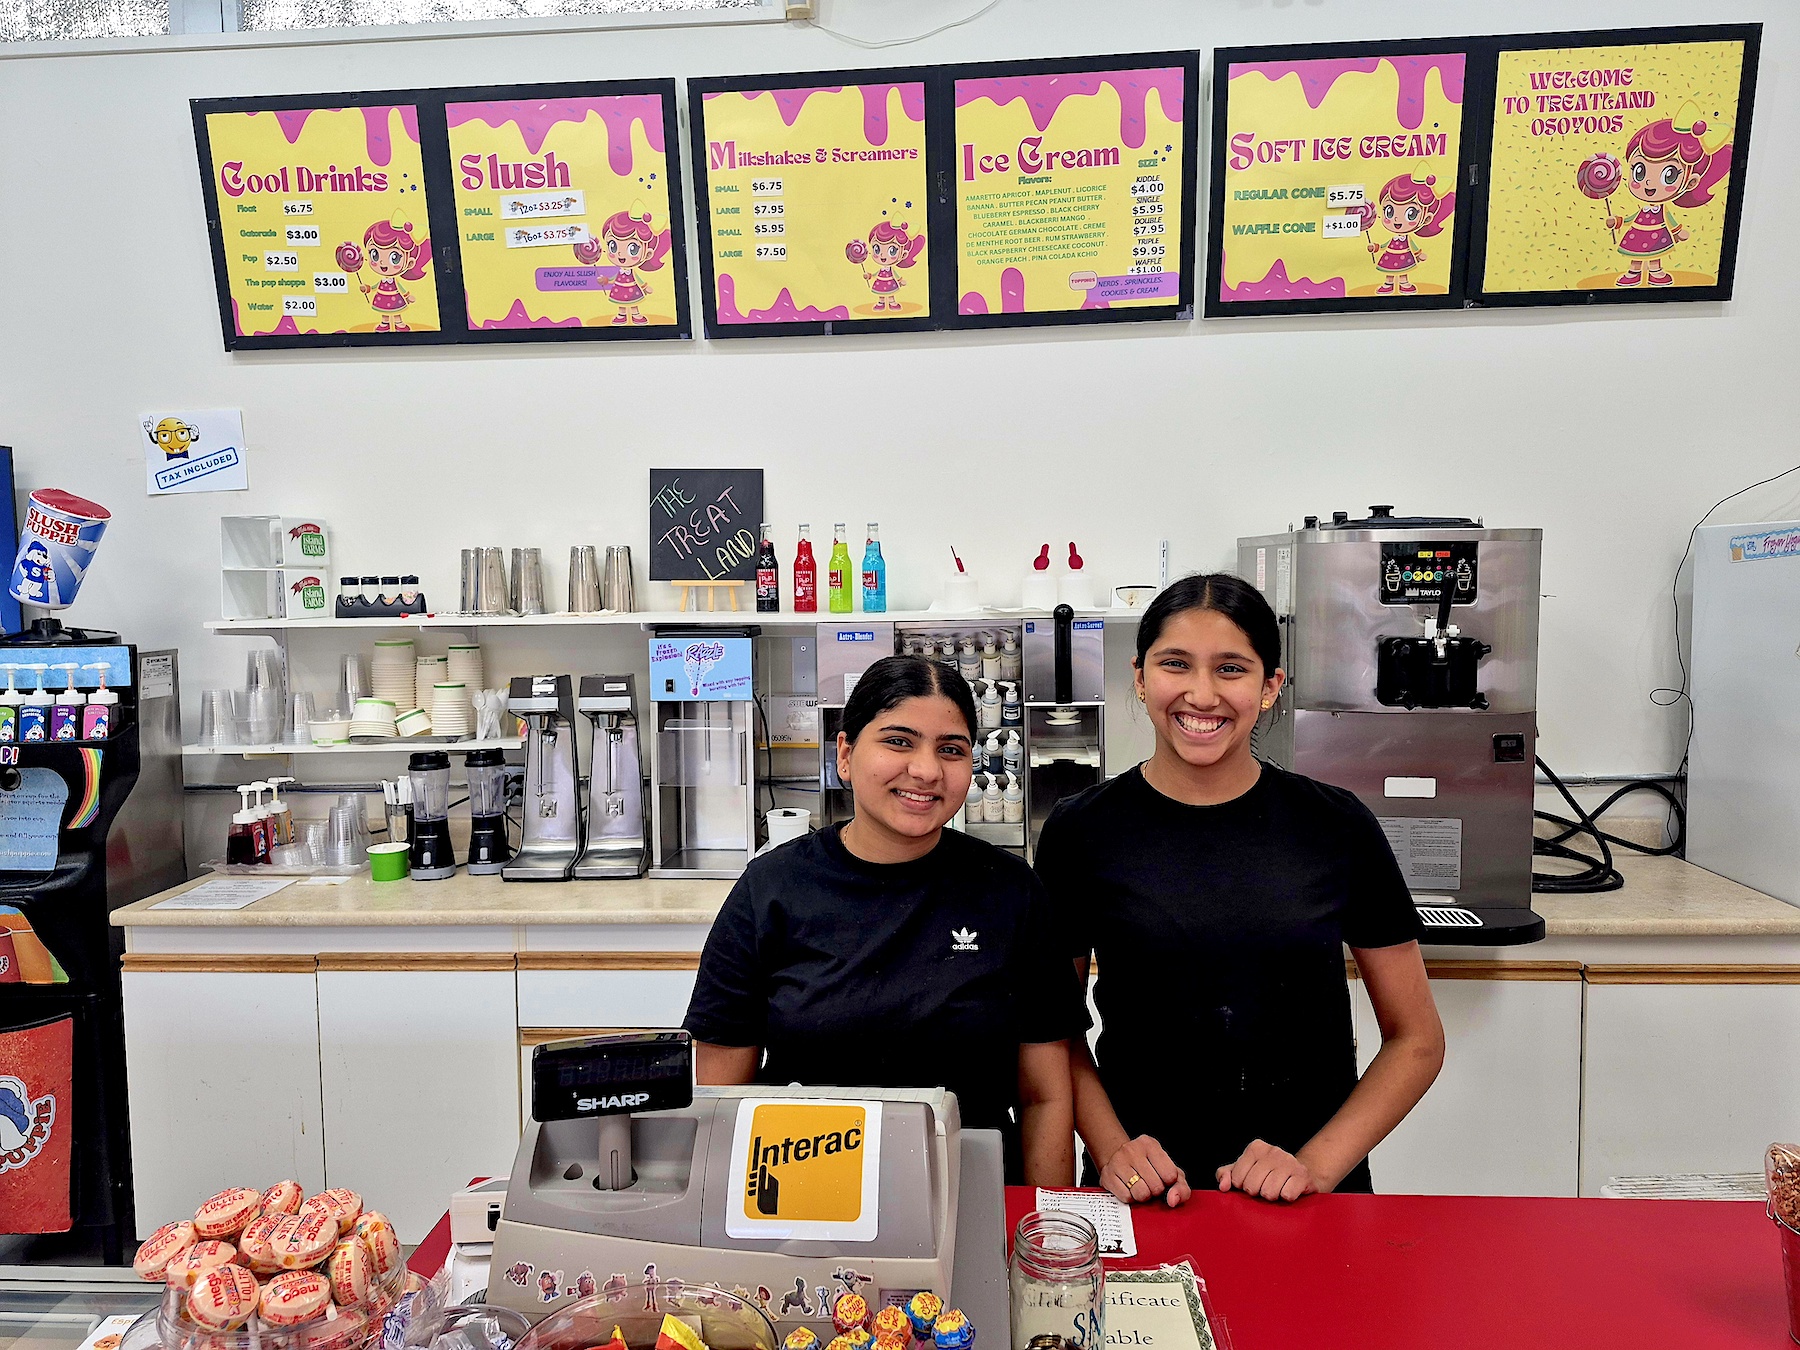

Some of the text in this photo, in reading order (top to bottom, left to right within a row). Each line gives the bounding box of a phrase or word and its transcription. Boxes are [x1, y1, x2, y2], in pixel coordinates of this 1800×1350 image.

[1530, 68, 1634, 90] WELCOME
[1504, 91, 1655, 115] TO TREATLAND
[1531, 115, 1624, 136] OSOYOOS
[710, 141, 918, 170] Milkshakes & Screamers
[1230, 132, 1447, 171] SOFT ICE CREAM
[963, 136, 1120, 181] Ice Cream
[1138, 159, 1158, 168] SIZE
[461, 152, 571, 190] Slush
[221, 161, 388, 197] Cool Drinks
[1018, 176, 1052, 185] Flavors:
[752, 182, 782, 191] $6.75
[1131, 183, 1164, 195] $4.00
[966, 185, 1107, 202] AMARETTO APRICOT MAPLENUT LICORICE
[1234, 187, 1325, 200] REGULAR CONE
[1329, 191, 1363, 201] $5.75
[1000, 201, 1024, 209] BUTTER
[1026, 199, 1048, 207] PECAN
[1077, 194, 1103, 202] BUTTER
[1136, 196, 1160, 204] SINGLE
[237, 205, 257, 213] Float
[284, 204, 313, 214] $6.75
[464, 208, 493, 216] SMALL
[519, 201, 563, 215] 12oz $3.25
[754, 205, 784, 215] $7.95
[1013, 209, 1046, 217] ESPRESSO
[1132, 205, 1163, 215] $5.95
[1135, 217, 1162, 225] DOUBLE
[1325, 221, 1358, 230] +$1.00
[240, 229, 277, 238] Gatorade
[755, 224, 784, 234] $5.95
[968, 222, 1106, 239] CHOCOLATE GERMAN CHOCOLATE CREME
[1134, 225, 1164, 236] $7.95
[1233, 222, 1316, 235] WAFFLE CONE
[287, 231, 318, 240] $3.00
[466, 233, 494, 241] LARGE
[523, 230, 567, 243] 16oz $3.75
[976, 239, 1003, 247] MENTHE
[1024, 236, 1041, 244] BEER
[1062, 232, 1106, 240] STRAWBERRY
[756, 247, 786, 257] $7.50
[990, 247, 1026, 255] RASPBERRY
[1028, 244, 1071, 252] CHEESECAKE
[1072, 241, 1105, 249] COCONUT
[1133, 246, 1165, 257] $9.95
[243, 255, 258, 264] Pop
[267, 256, 297, 266] $2.50
[977, 258, 1004, 266] ORANGE
[1049, 252, 1076, 260] COLADA
[1136, 258, 1162, 266] WAFFLE
[1130, 266, 1162, 274] +$1.00
[246, 279, 306, 287] The pop shoppe
[315, 278, 345, 287] $3.00
[1101, 289, 1128, 297] COOKIES
[285, 301, 315, 310] $2.00
[162, 454, 232, 483] TAX INCLUDED
[650, 477, 696, 518] THE
[29, 507, 81, 536] SLUSH
[658, 486, 741, 560] TREAT
[304, 545, 324, 555] FARMS
[697, 529, 756, 581] LAND
[305, 597, 324, 607] FARMS
[577, 1093, 650, 1112] SHARP
[752, 1127, 862, 1170] Interac
[204, 1193, 245, 1215] LOLLIES
[138, 1233, 177, 1263] LOLLIES
[206, 1273, 224, 1307] mega
[237, 1267, 252, 1302] LOLLIES
[282, 1285, 319, 1303] mega
[1105, 1291, 1182, 1308] tificate
